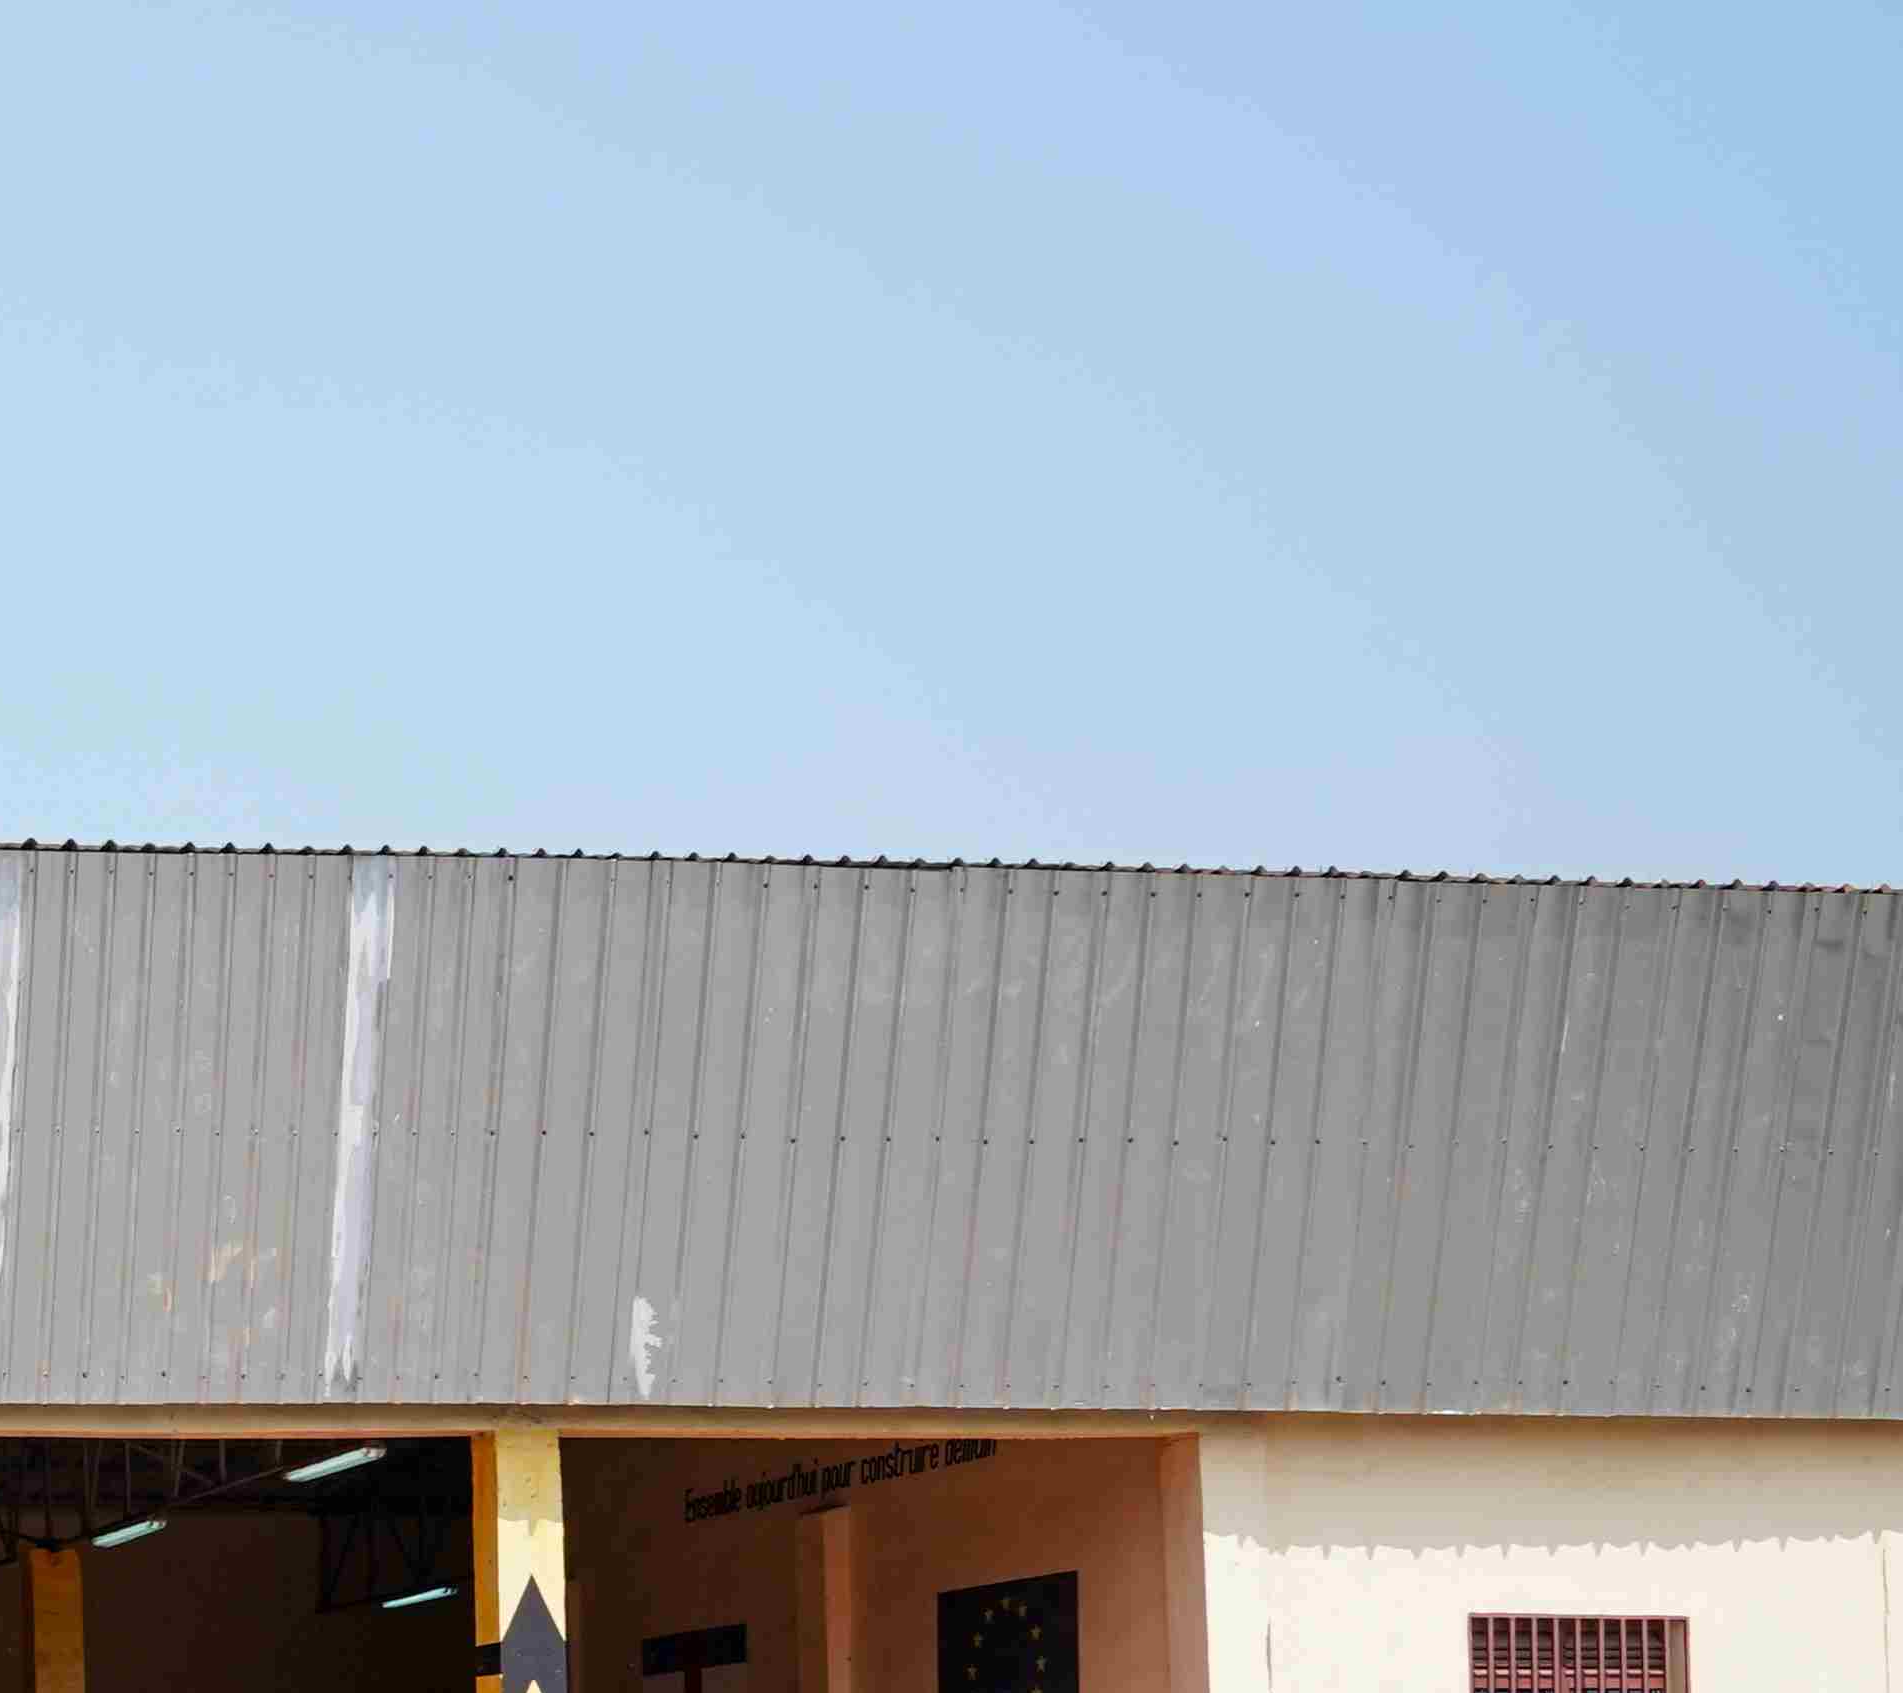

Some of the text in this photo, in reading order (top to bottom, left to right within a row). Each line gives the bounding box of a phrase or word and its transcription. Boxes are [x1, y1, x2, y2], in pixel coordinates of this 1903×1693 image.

[684, 1477, 742, 1523] Ensemble
[821, 1461, 856, 1498] pour
[861, 1440, 939, 1485] construire
